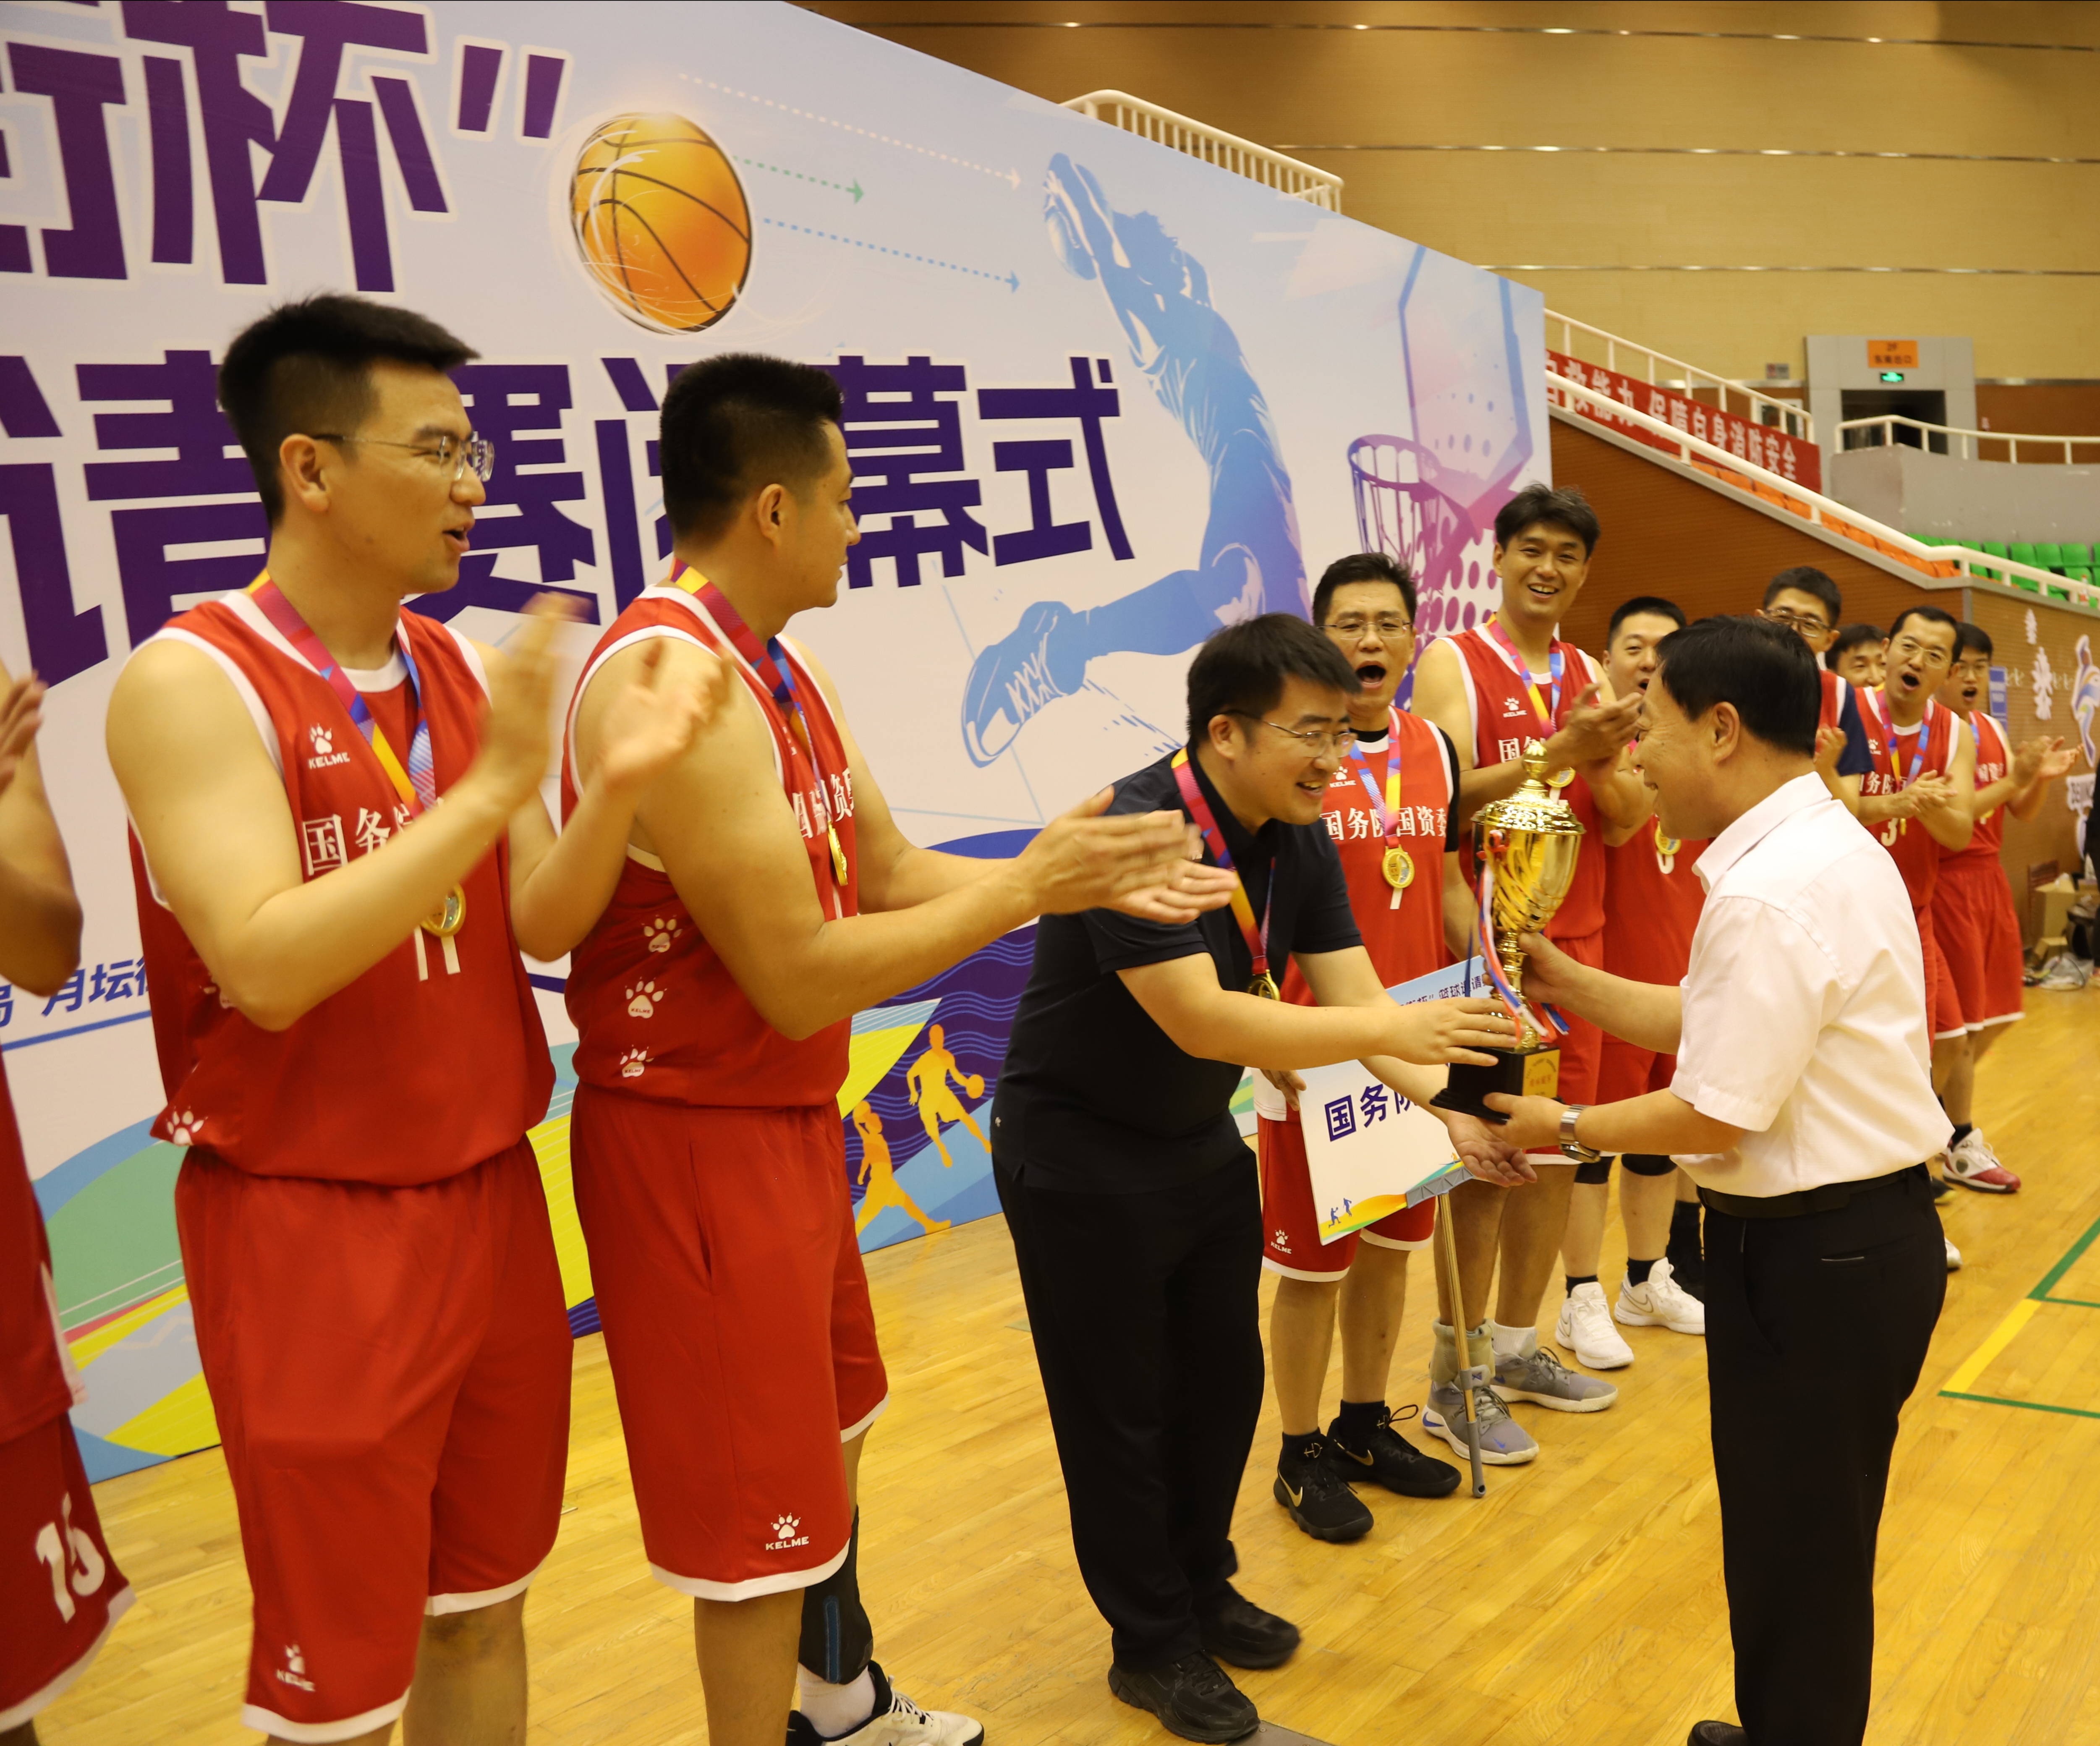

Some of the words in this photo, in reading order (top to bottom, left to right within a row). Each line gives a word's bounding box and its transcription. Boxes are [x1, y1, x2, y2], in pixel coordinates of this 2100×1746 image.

[309, 752, 350, 769] KELME
[1271, 1241, 1292, 1254] KELME
[766, 1536, 809, 1550] KELME
